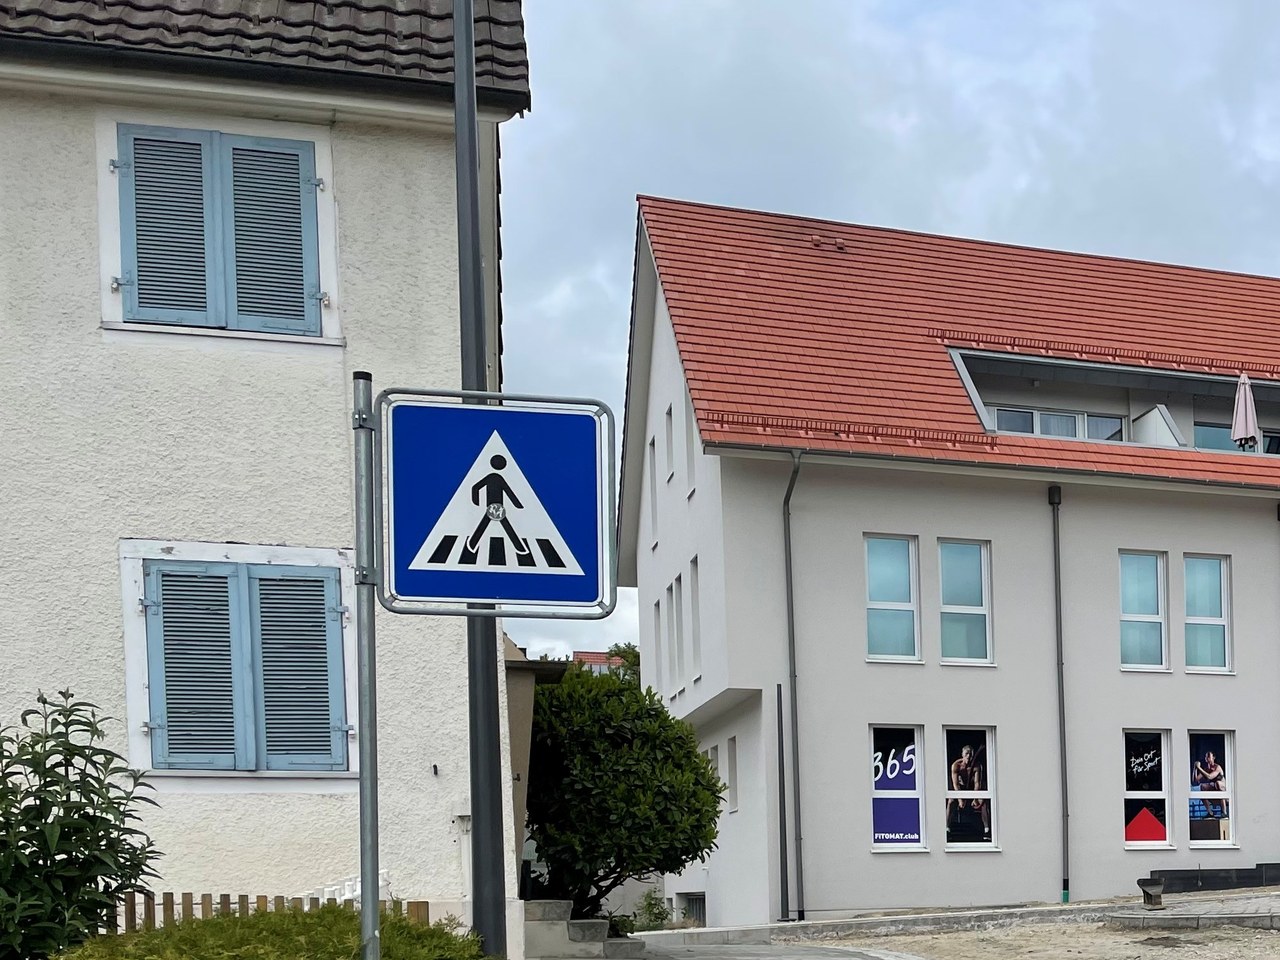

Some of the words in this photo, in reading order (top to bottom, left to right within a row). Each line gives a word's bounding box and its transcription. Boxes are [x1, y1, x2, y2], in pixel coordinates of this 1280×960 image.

[873, 745, 915, 781] 365
[1144, 750, 1156, 761] Ort
[1132, 765, 1144, 774] für
[1144, 757, 1161, 771] Sport
